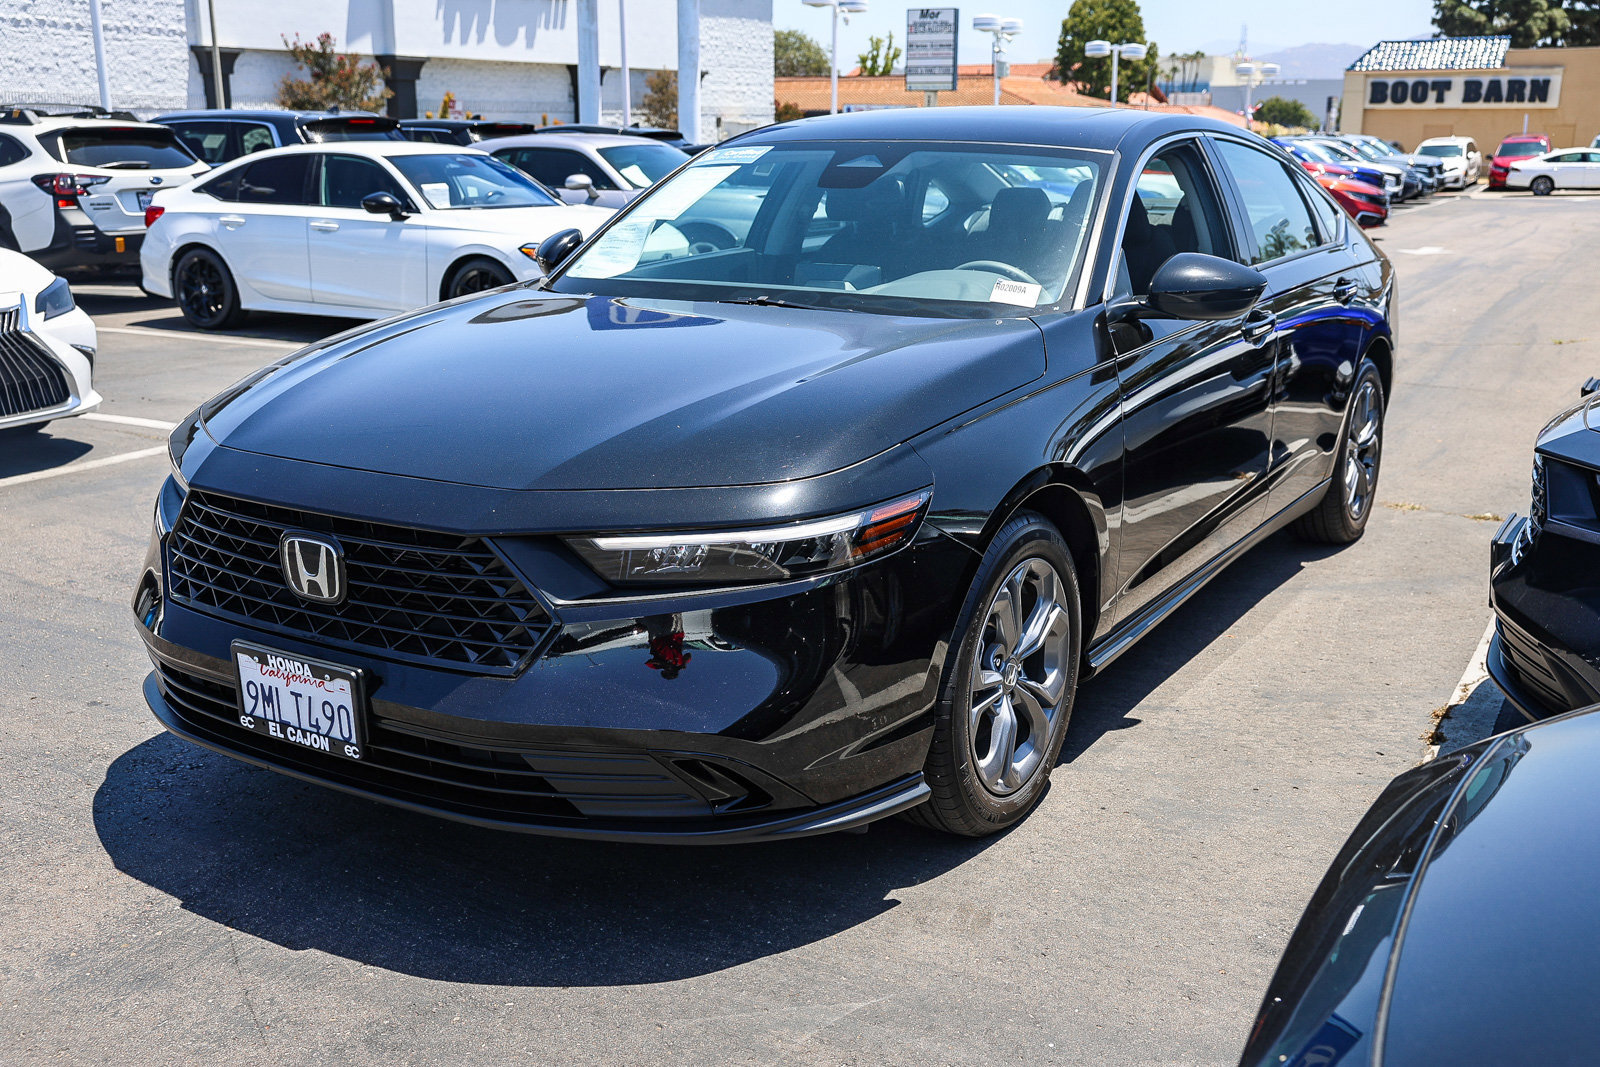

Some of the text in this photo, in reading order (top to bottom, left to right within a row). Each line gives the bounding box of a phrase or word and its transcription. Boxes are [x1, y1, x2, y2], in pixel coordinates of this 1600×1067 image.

[1369, 78, 1551, 104] BOOT BARN
[995, 283, 1027, 294] R02009A
[260, 664, 334, 693] California
[266, 654, 313, 678] HONDA
[246, 680, 353, 742] 9MLT490
[268, 721, 330, 751] EL CAJON
